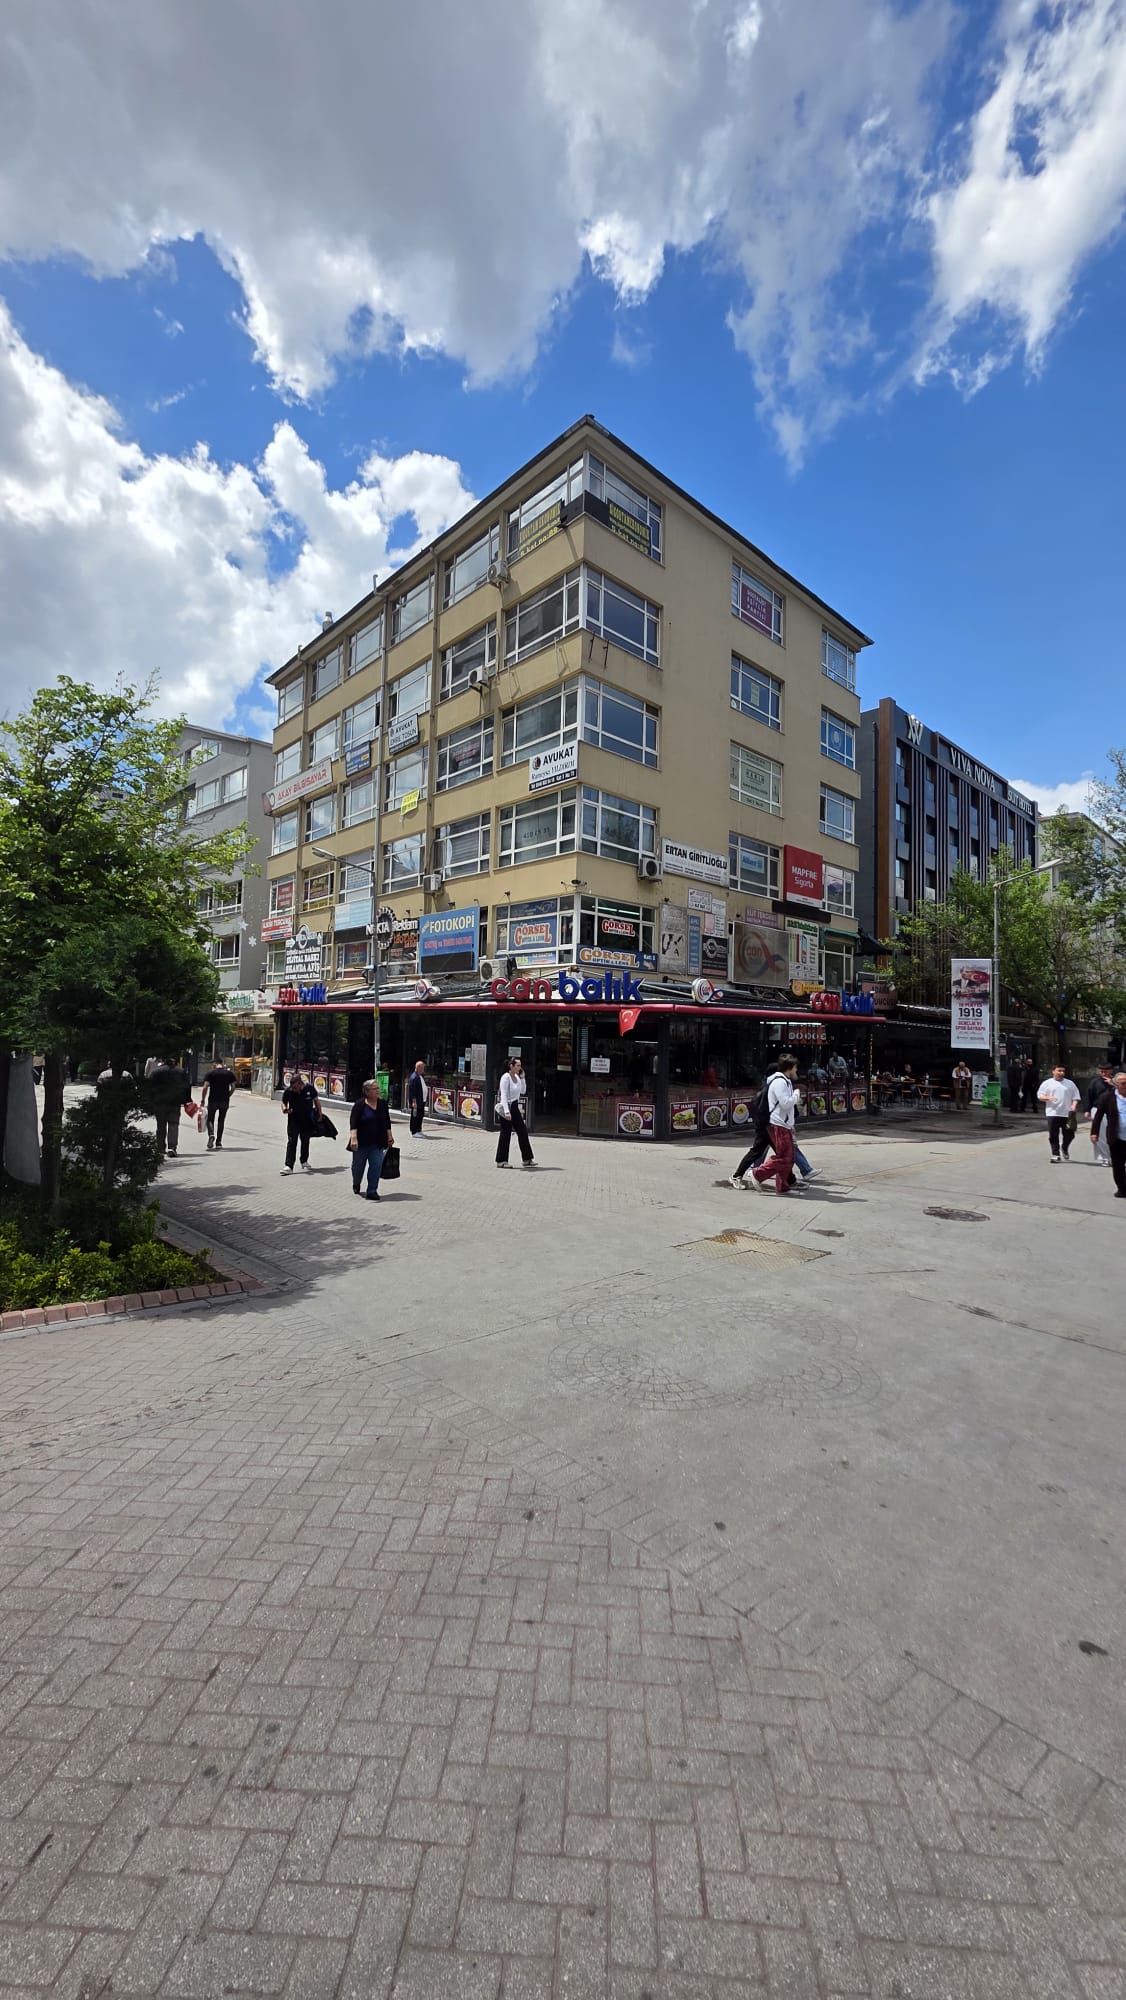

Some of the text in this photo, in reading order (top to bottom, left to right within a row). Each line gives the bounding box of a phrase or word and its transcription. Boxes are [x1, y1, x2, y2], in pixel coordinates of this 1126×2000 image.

[395, 720, 413, 734] AVUKAT
[543, 746, 574, 766] AVUKAT
[951, 747, 995, 793] VIVA NOVA
[665, 844, 687, 859] ERTAN
[689, 849, 728, 870] GİRİTLİOĞLU
[791, 865, 818, 880] MAPFRE
[794, 876, 814, 889] Sigorta
[430, 911, 475, 934] FOTOKOPİ
[602, 918, 635, 937] GÖRSEL
[515, 922, 552, 946] GÖRSEL
[580, 947, 640, 968] GÖRSEL
[490, 970, 645, 1001] can balık
[810, 992, 842, 1011] can
[958, 1007, 983, 1018] 1919
